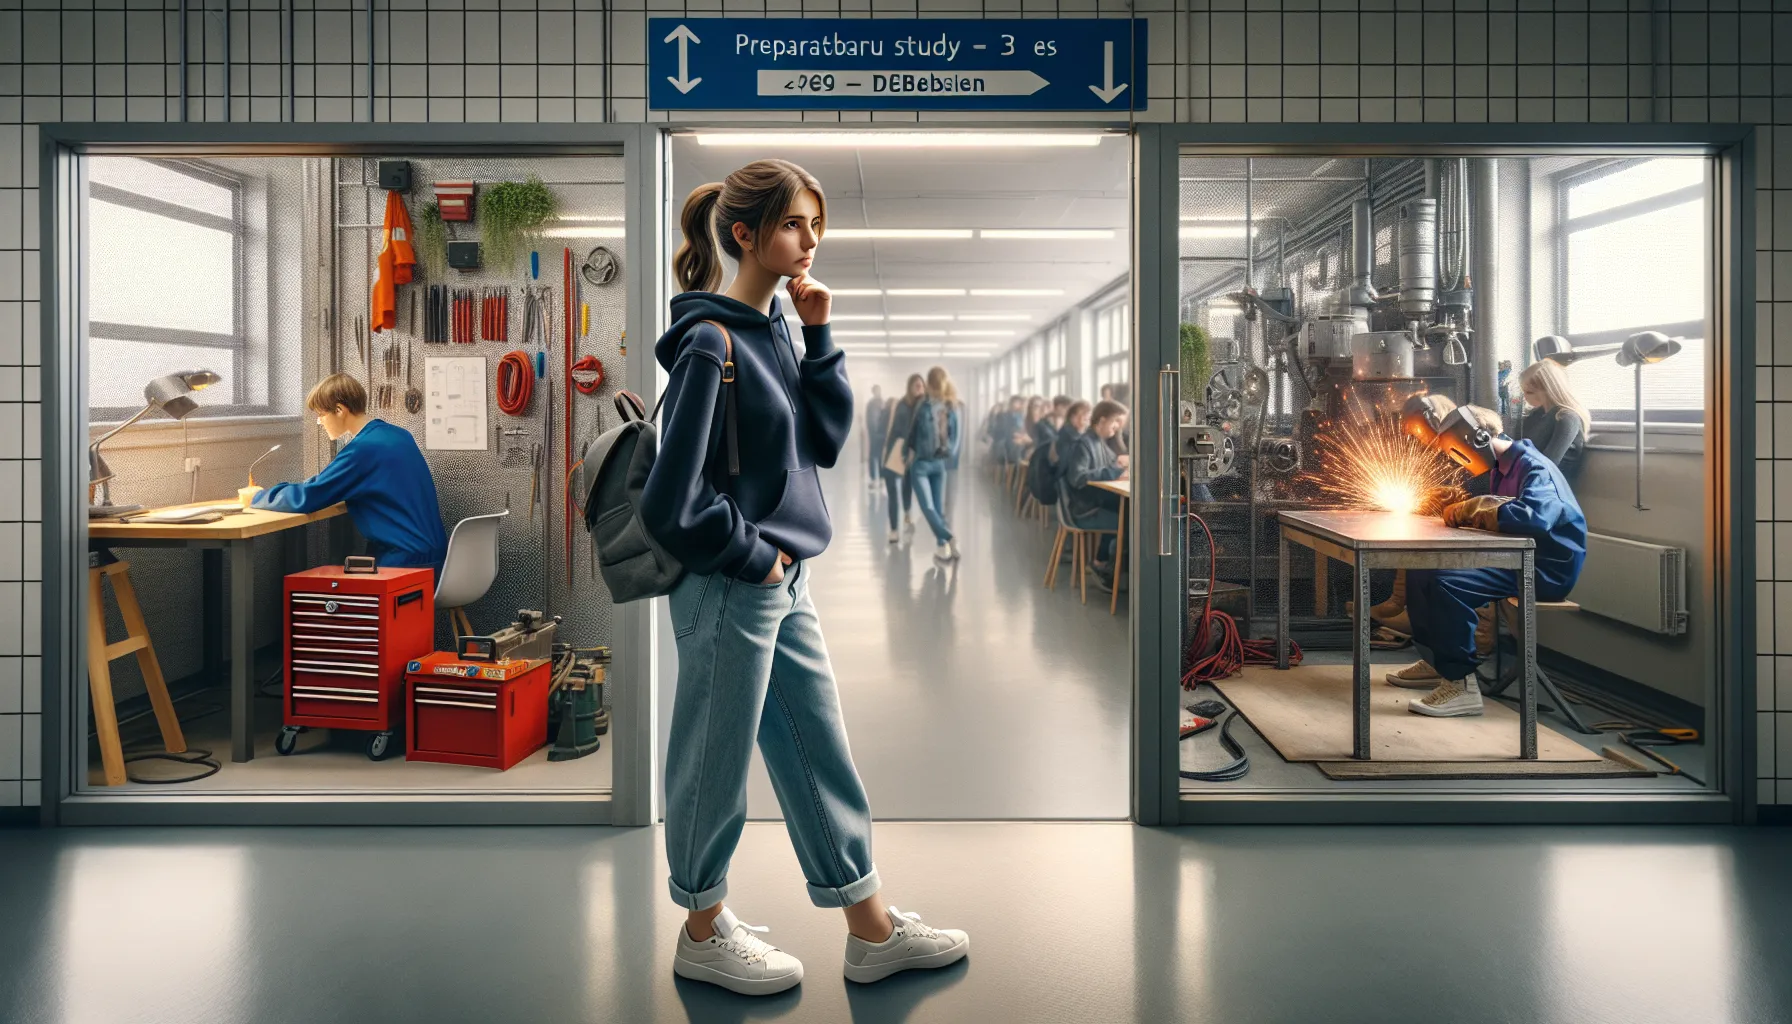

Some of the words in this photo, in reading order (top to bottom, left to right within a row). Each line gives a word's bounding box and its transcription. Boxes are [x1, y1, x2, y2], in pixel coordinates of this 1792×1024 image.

[894, 32, 961, 62] study
[1000, 33, 1016, 56] 3
[1034, 39, 1058, 57] es
